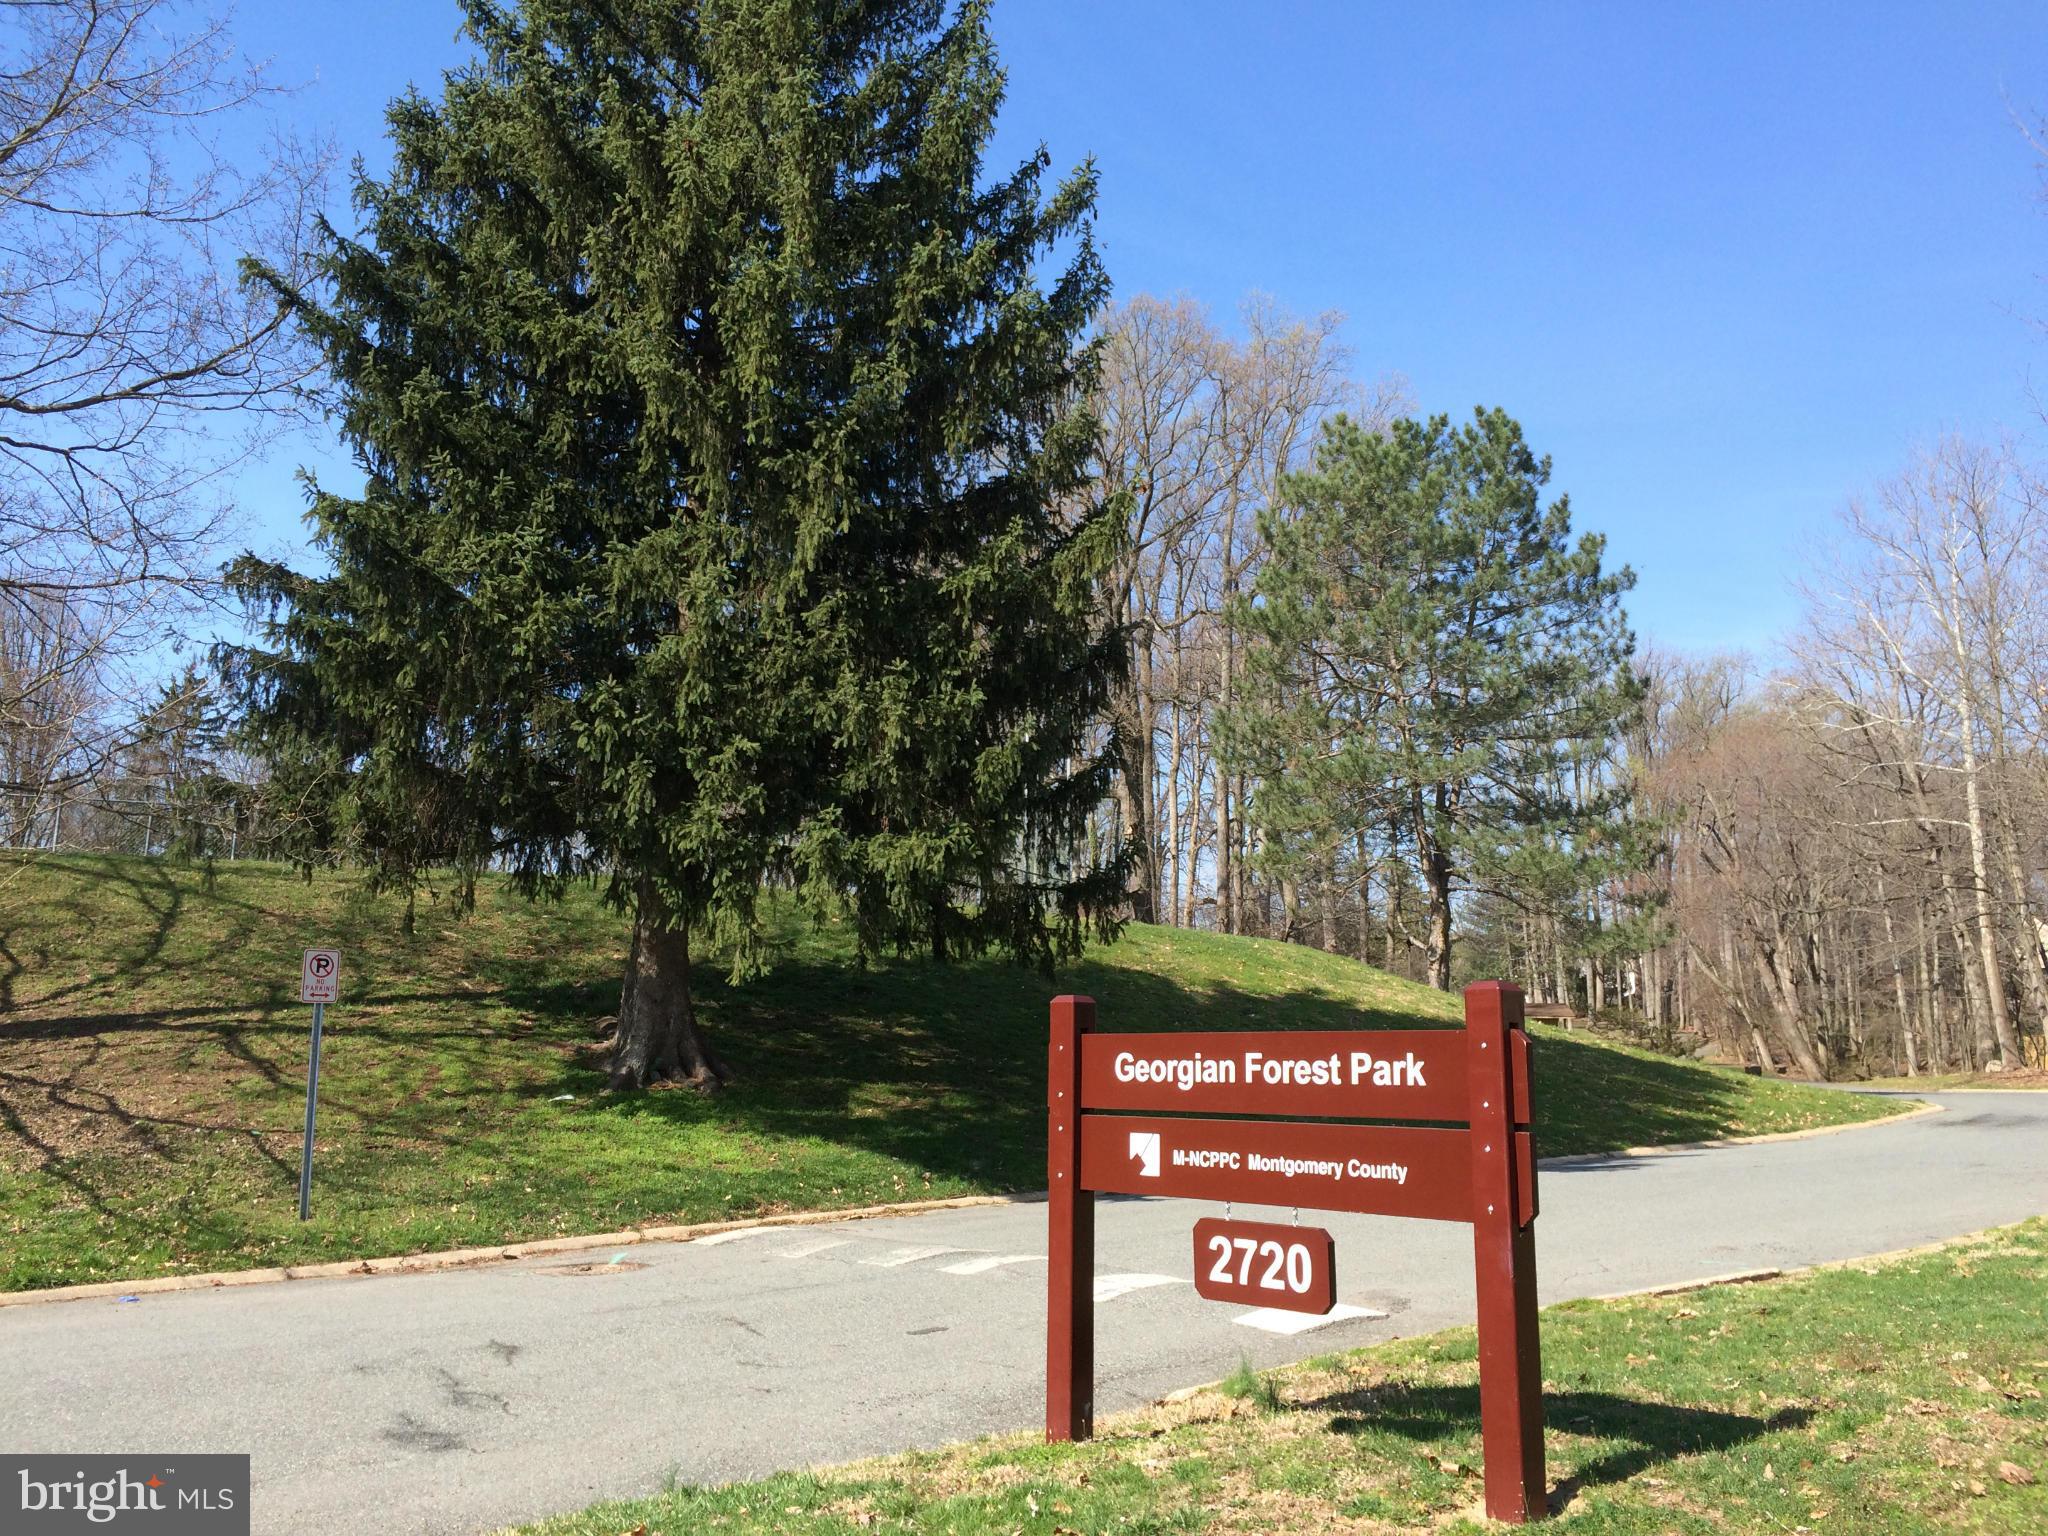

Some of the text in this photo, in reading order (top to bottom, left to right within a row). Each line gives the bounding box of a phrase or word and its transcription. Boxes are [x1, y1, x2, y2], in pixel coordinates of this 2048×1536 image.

[1114, 1052, 1427, 1090] Georgian Forest Park
[1173, 1149, 1408, 1184] M-NCPPC Montgomery County
[1208, 1236, 1313, 1294] 2720
